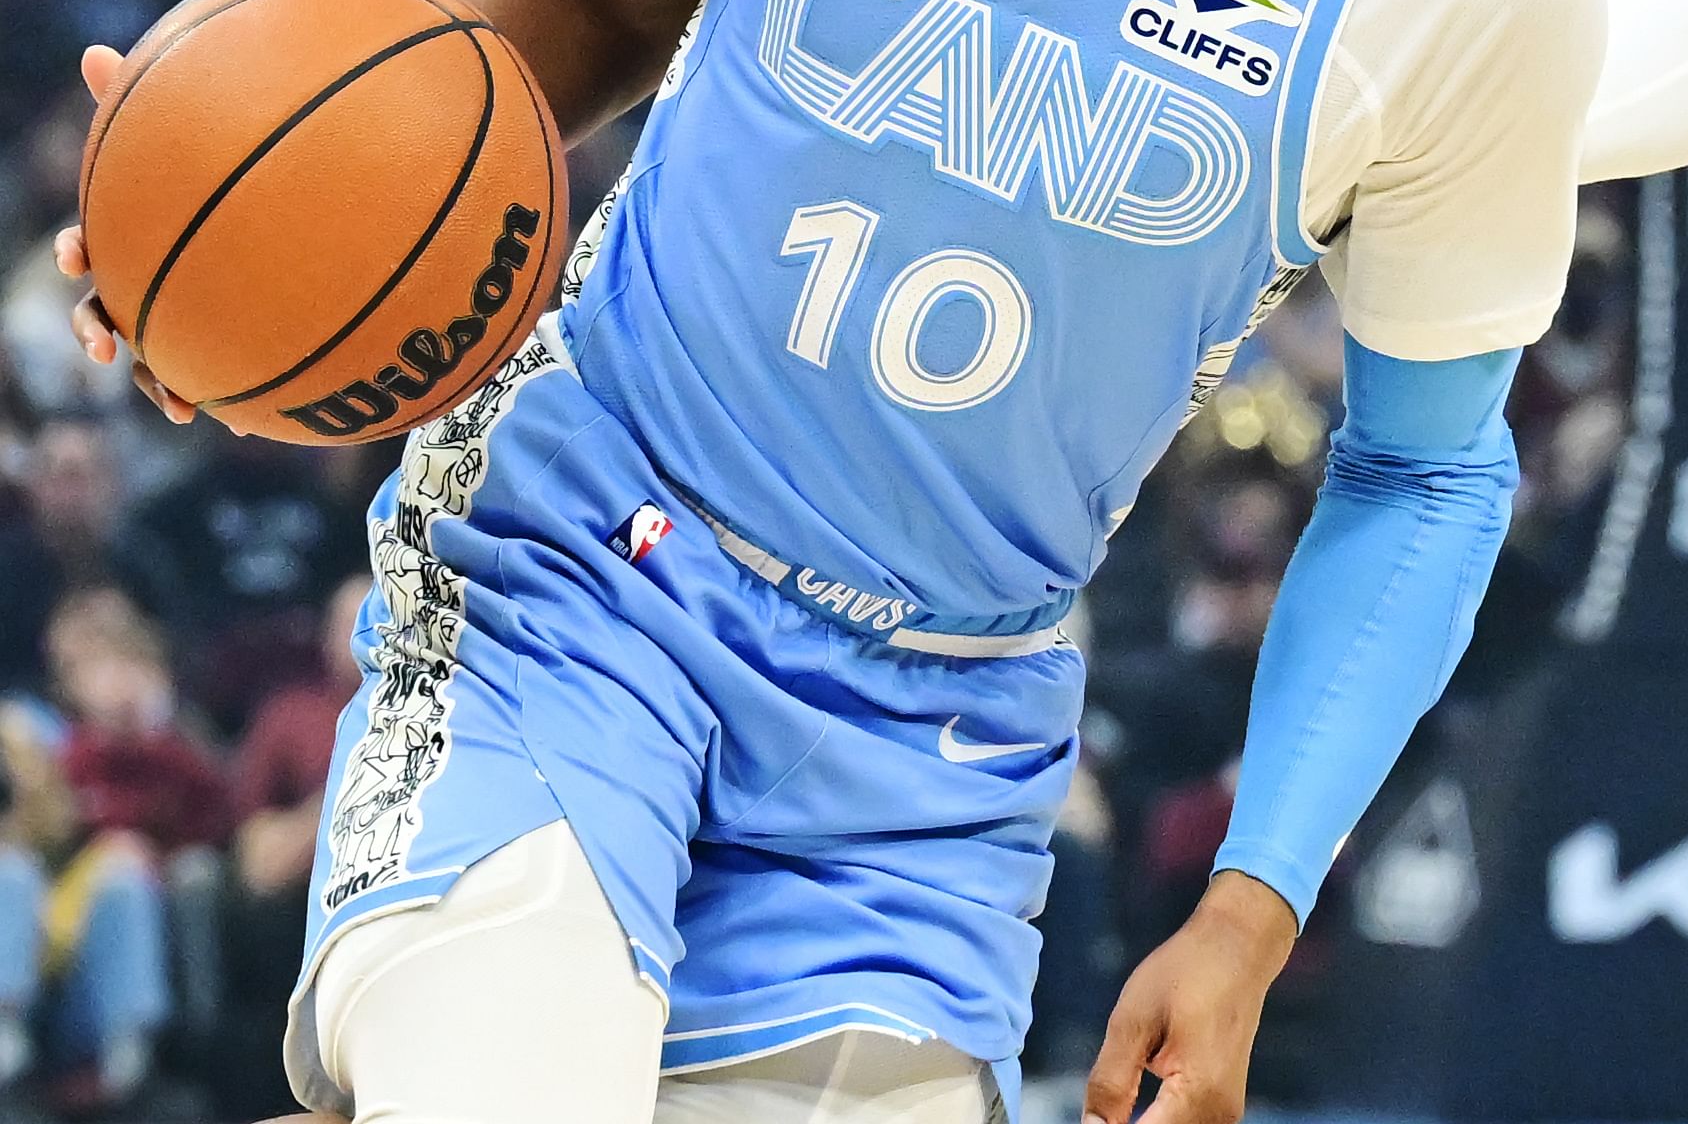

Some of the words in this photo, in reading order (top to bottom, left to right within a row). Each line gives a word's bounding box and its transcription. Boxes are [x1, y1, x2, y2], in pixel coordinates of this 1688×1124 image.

[1129, 6, 1274, 88] CLIFFS
[280, 202, 541, 437] Wilson
[779, 199, 1034, 413] 10
[609, 536, 630, 557] NBA
